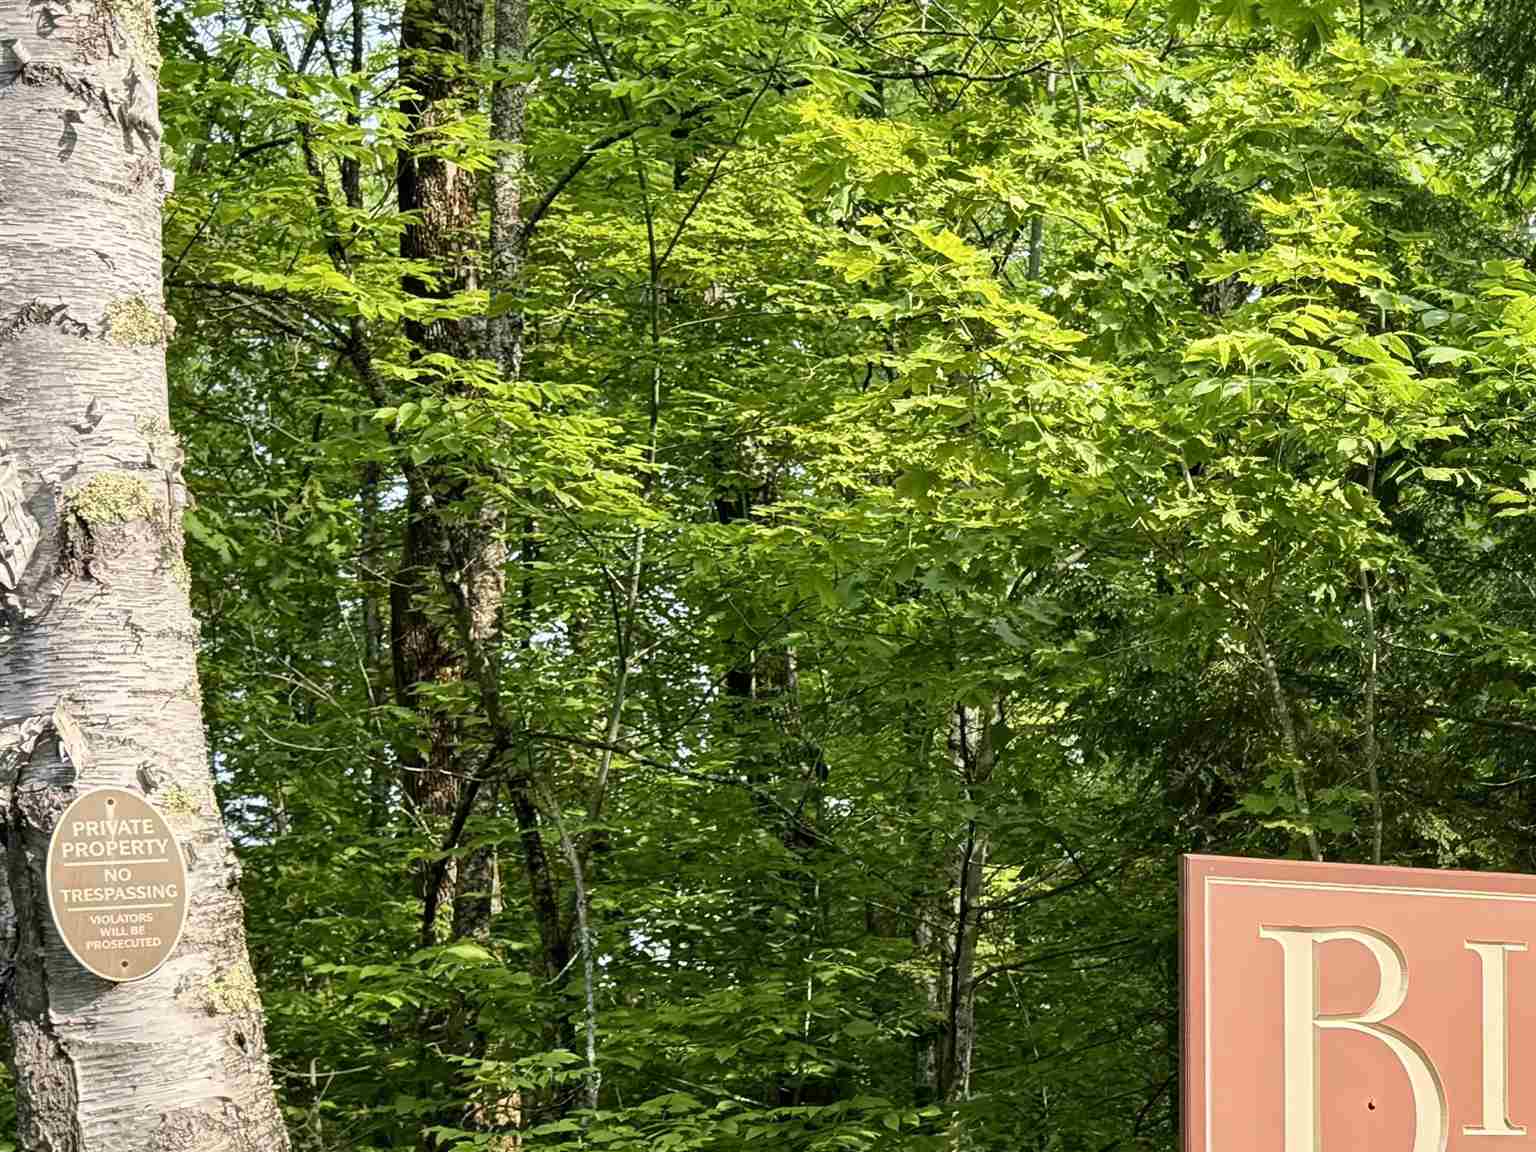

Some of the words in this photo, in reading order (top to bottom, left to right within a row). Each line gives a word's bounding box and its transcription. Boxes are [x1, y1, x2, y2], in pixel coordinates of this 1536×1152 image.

[71, 818, 155, 837] PRIVATE
[62, 838, 169, 858] PROPERTY
[103, 868, 132, 882] NO
[61, 884, 178, 903] TRESPASSING
[89, 912, 153, 925] VIOLATORS
[99, 926, 129, 937] WILL
[130, 925, 145, 936] BE
[86, 937, 161, 950] PROSECUTED
